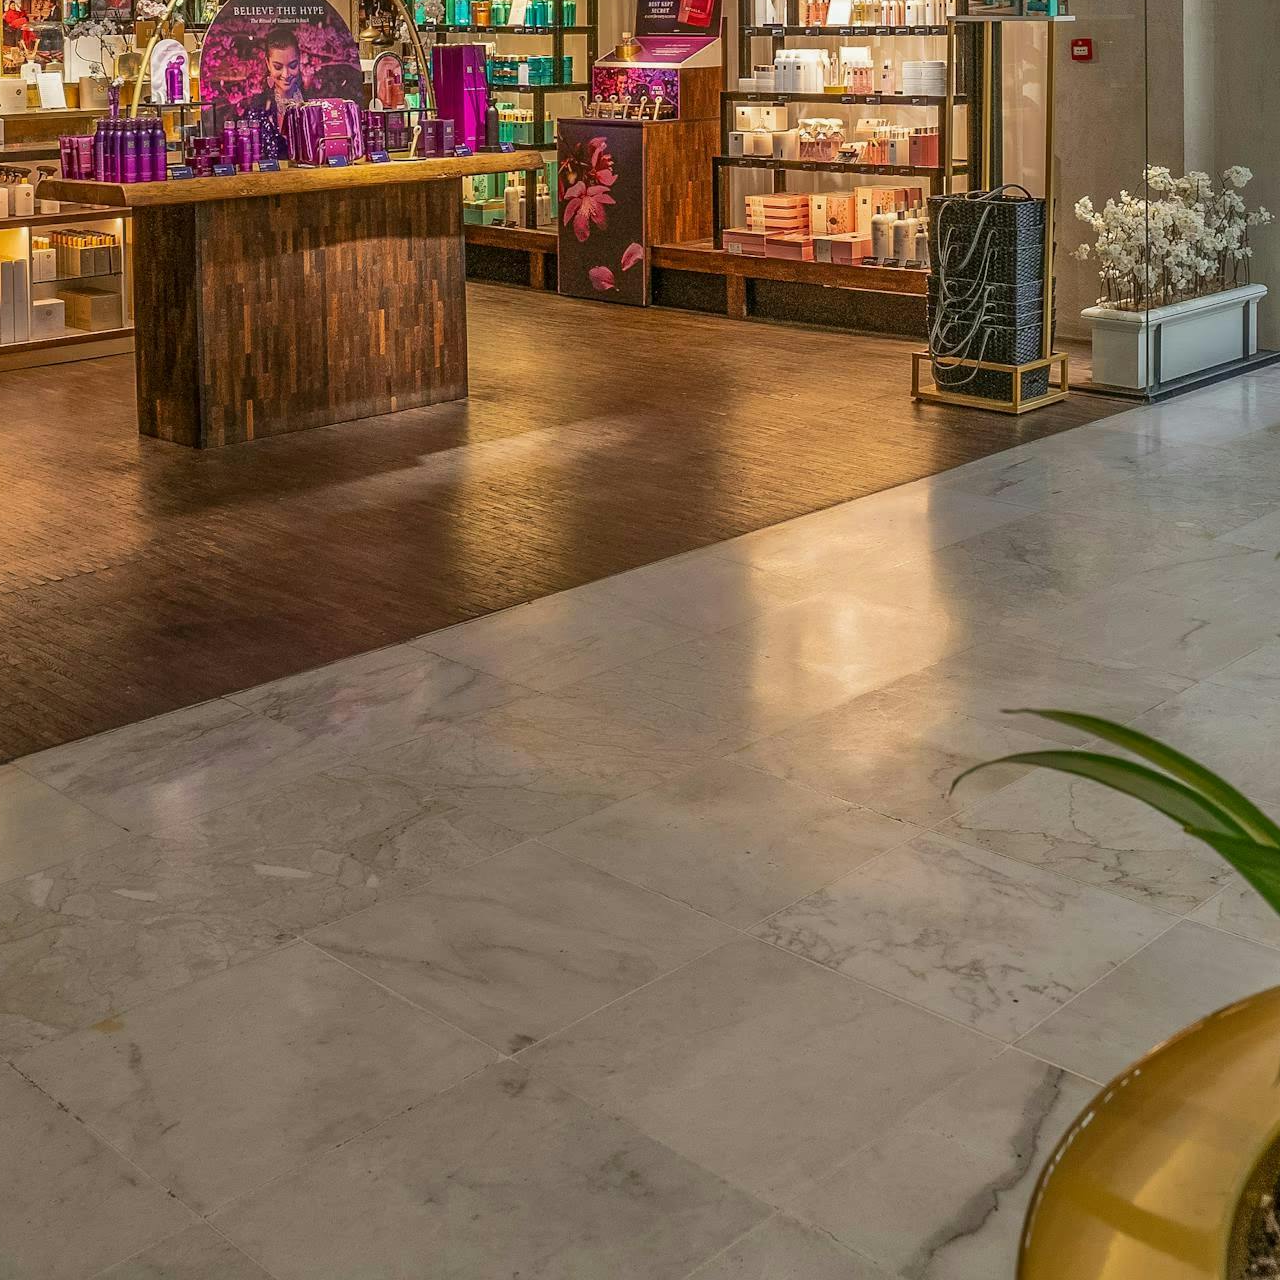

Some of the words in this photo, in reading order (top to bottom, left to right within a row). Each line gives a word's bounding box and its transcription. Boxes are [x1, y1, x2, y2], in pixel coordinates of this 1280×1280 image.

[233, 6, 274, 15] BELIEVE
[276, 6, 297, 15] THE
[300, 6, 325, 15] HYPE
